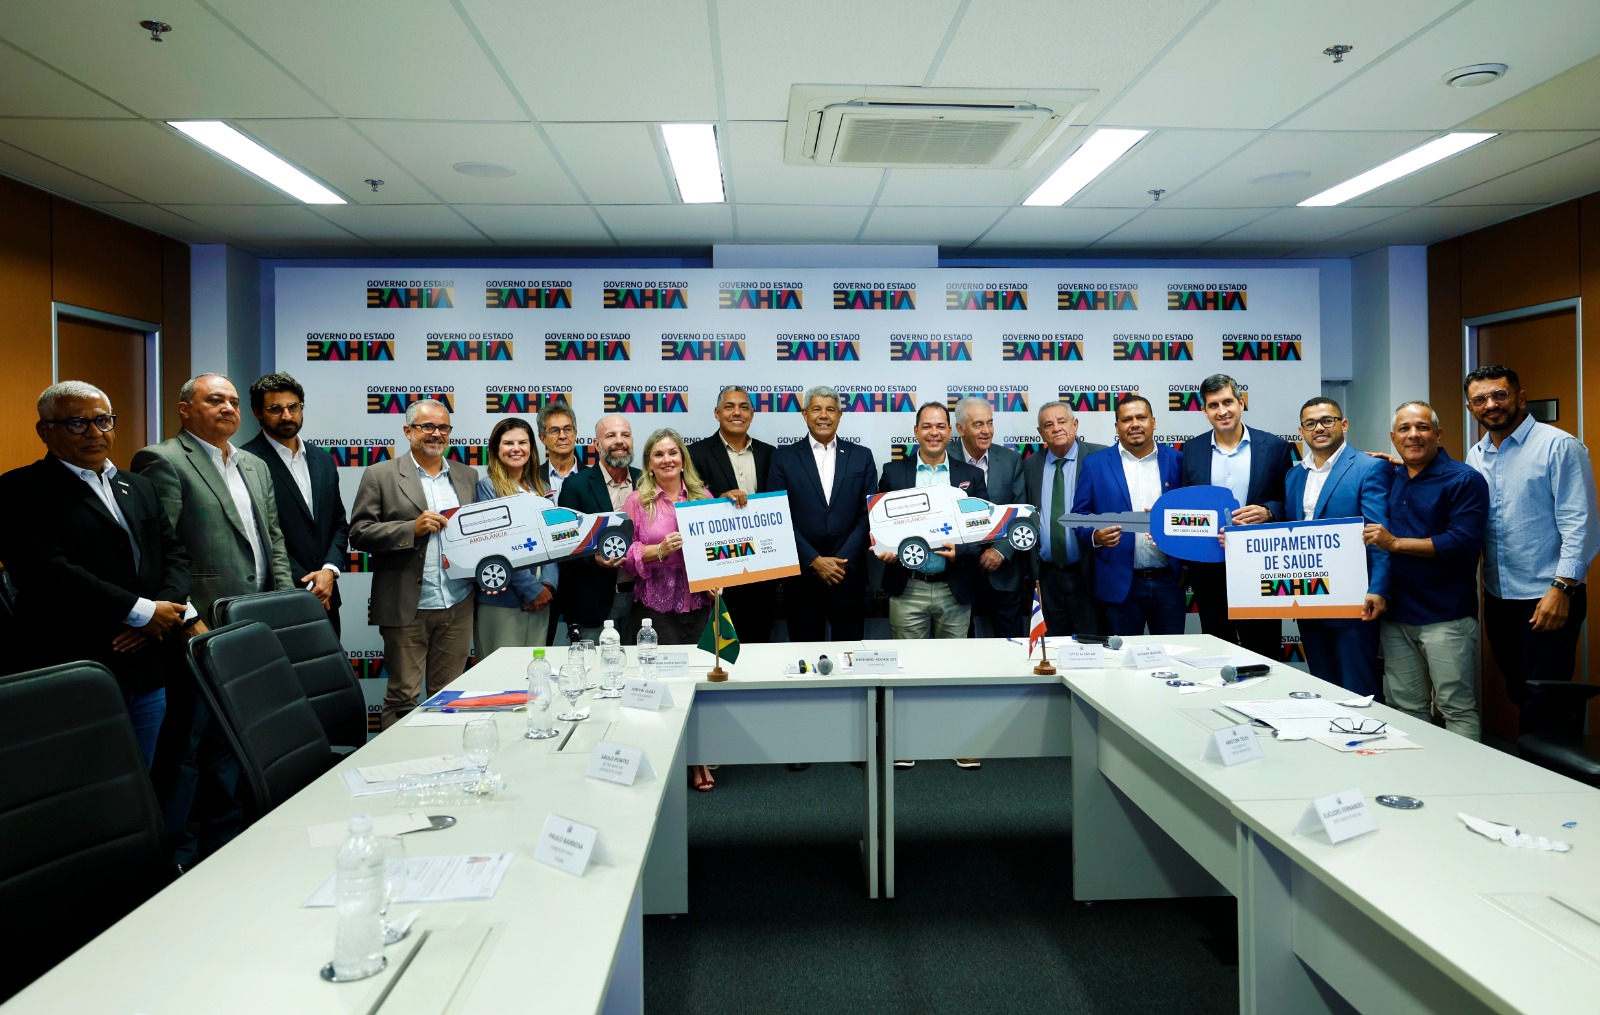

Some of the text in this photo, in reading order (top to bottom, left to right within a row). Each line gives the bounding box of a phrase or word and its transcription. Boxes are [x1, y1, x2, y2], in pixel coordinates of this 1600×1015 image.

[688, 511, 783, 536] KIT ODONTOLÓGICO
[1246, 533, 1340, 553] EQUIPAMENTOS
[1264, 552, 1323, 570] DE SAÚDE
